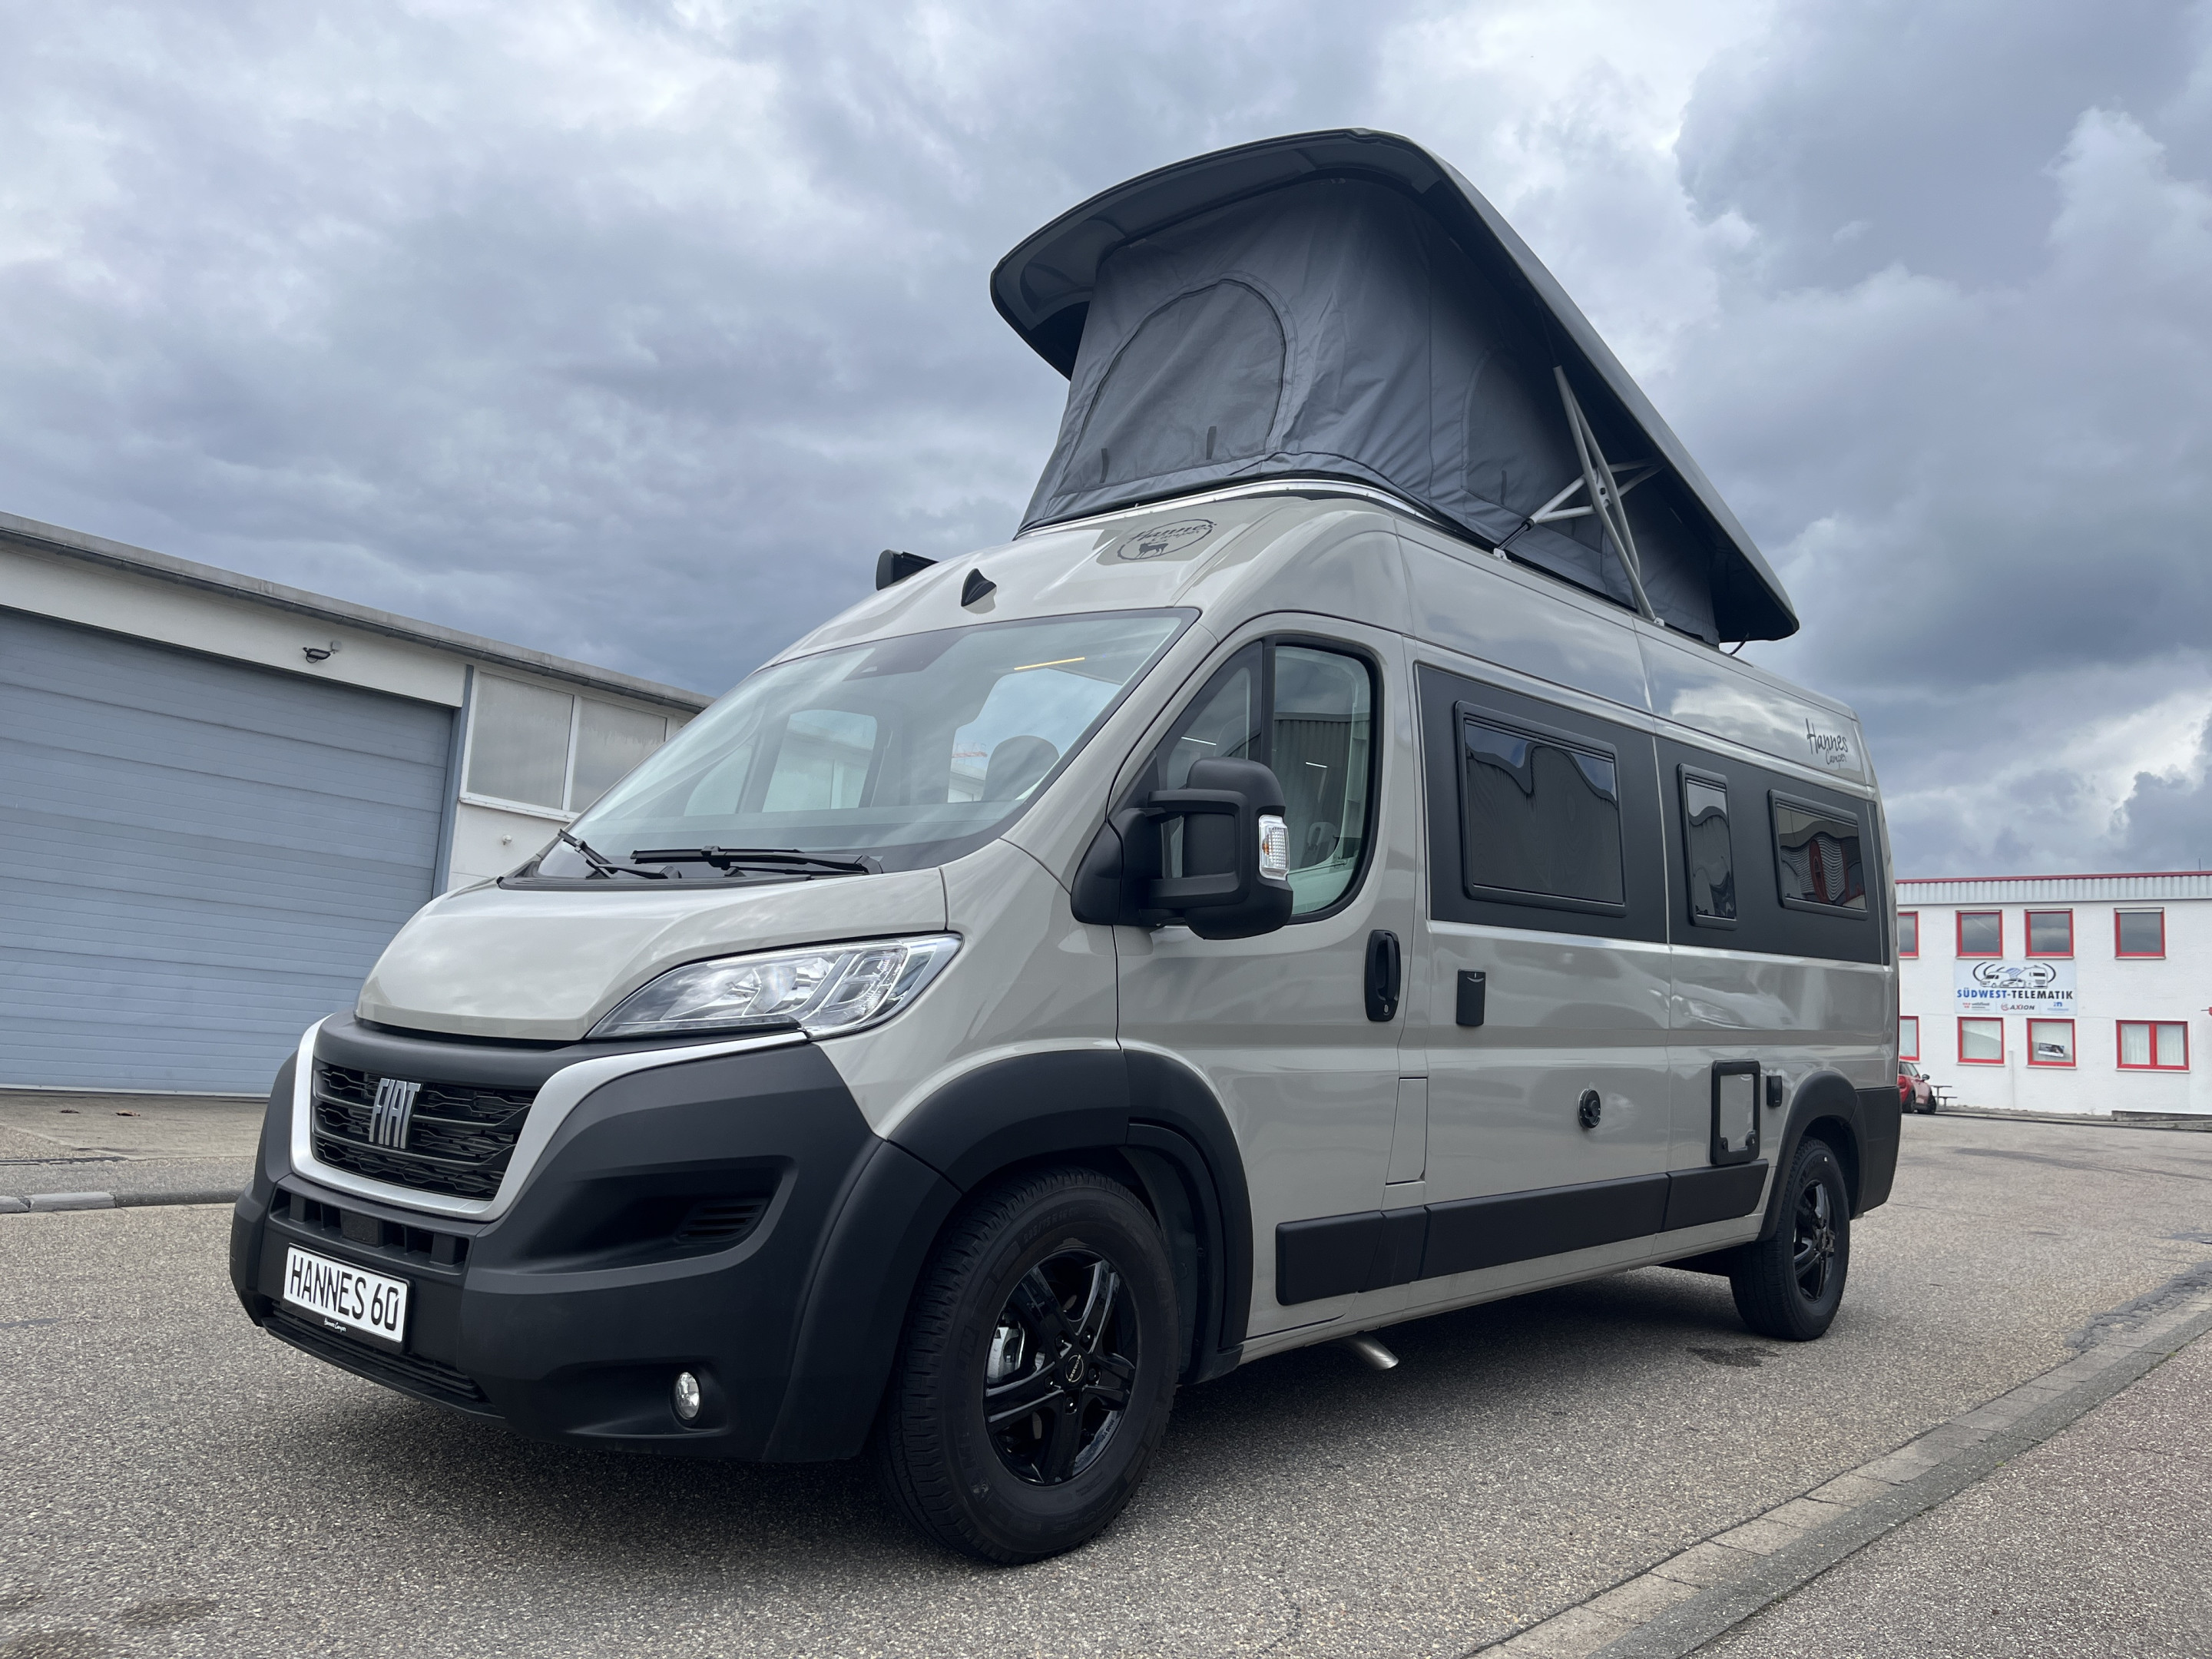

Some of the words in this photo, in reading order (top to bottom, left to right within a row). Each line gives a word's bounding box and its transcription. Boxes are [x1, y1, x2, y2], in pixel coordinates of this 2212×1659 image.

[1126, 524, 1217, 544] Hannes
[1805, 717, 1849, 755] Hannes
[1825, 748, 1847, 769] Camper
[1956, 988, 2074, 1000] SÜDWEST-TELEMATIK
[368, 1078, 422, 1149] FIAT
[290, 1254, 366, 1320] HANNES
[370, 1283, 399, 1332] 60
